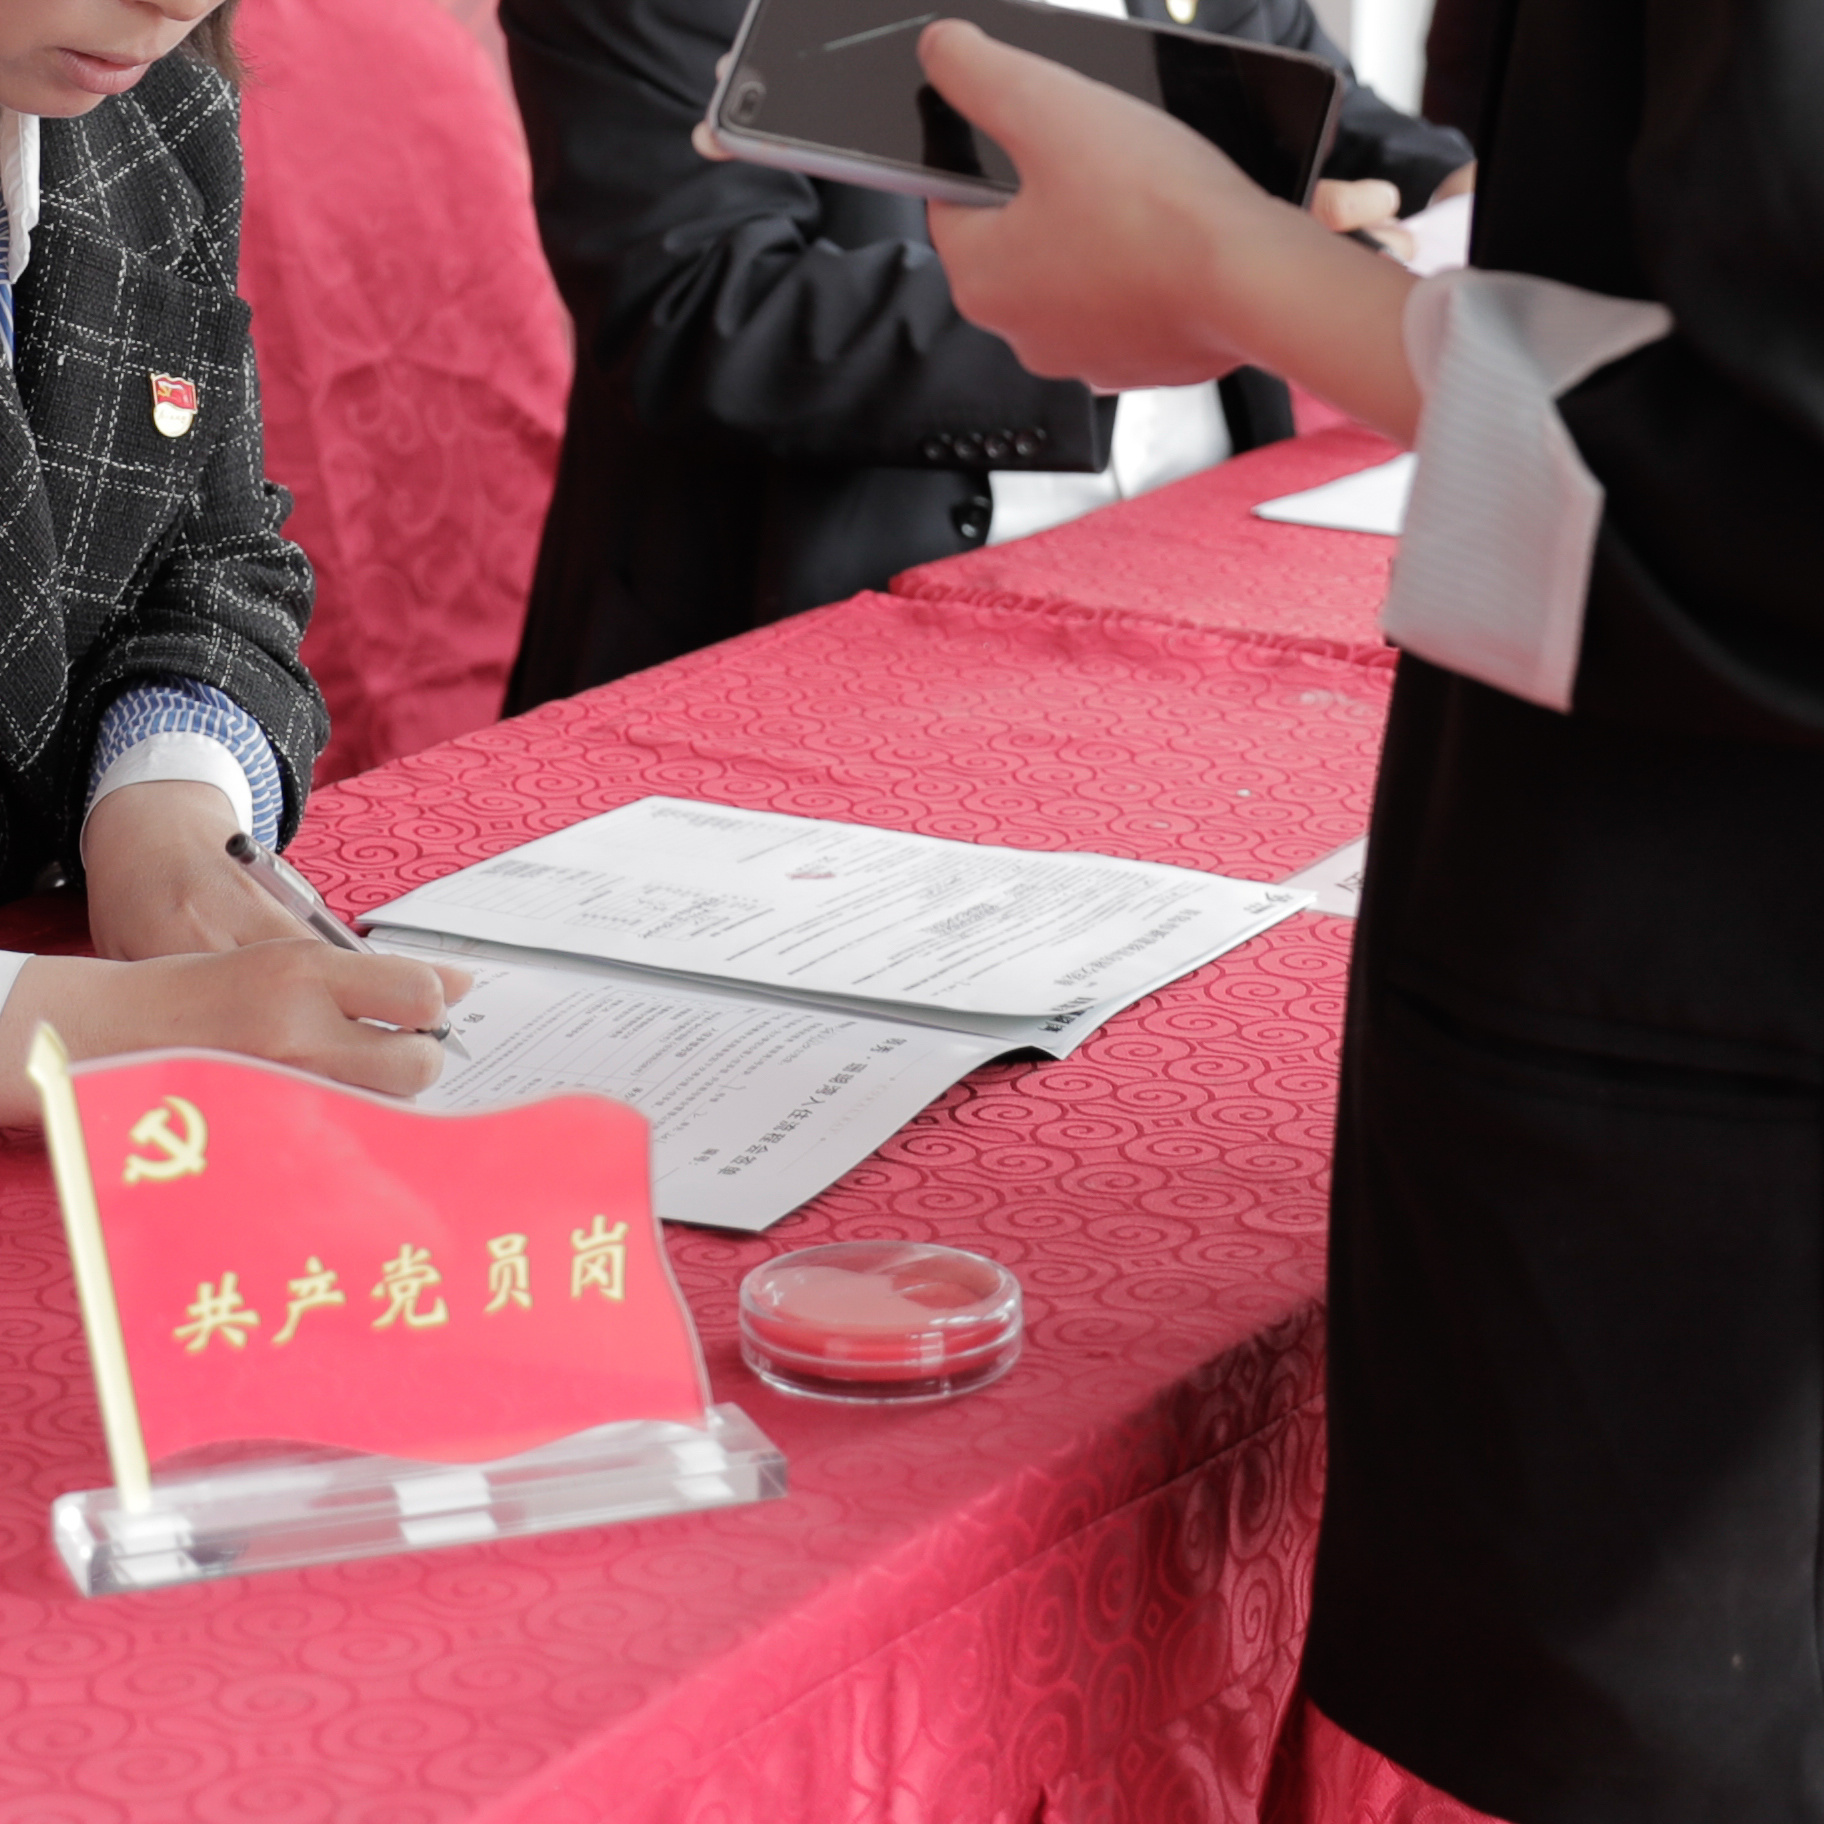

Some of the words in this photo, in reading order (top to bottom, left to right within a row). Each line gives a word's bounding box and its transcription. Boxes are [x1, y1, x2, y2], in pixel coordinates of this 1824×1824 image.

[174, 1214, 630, 1353] 共产党员岗
